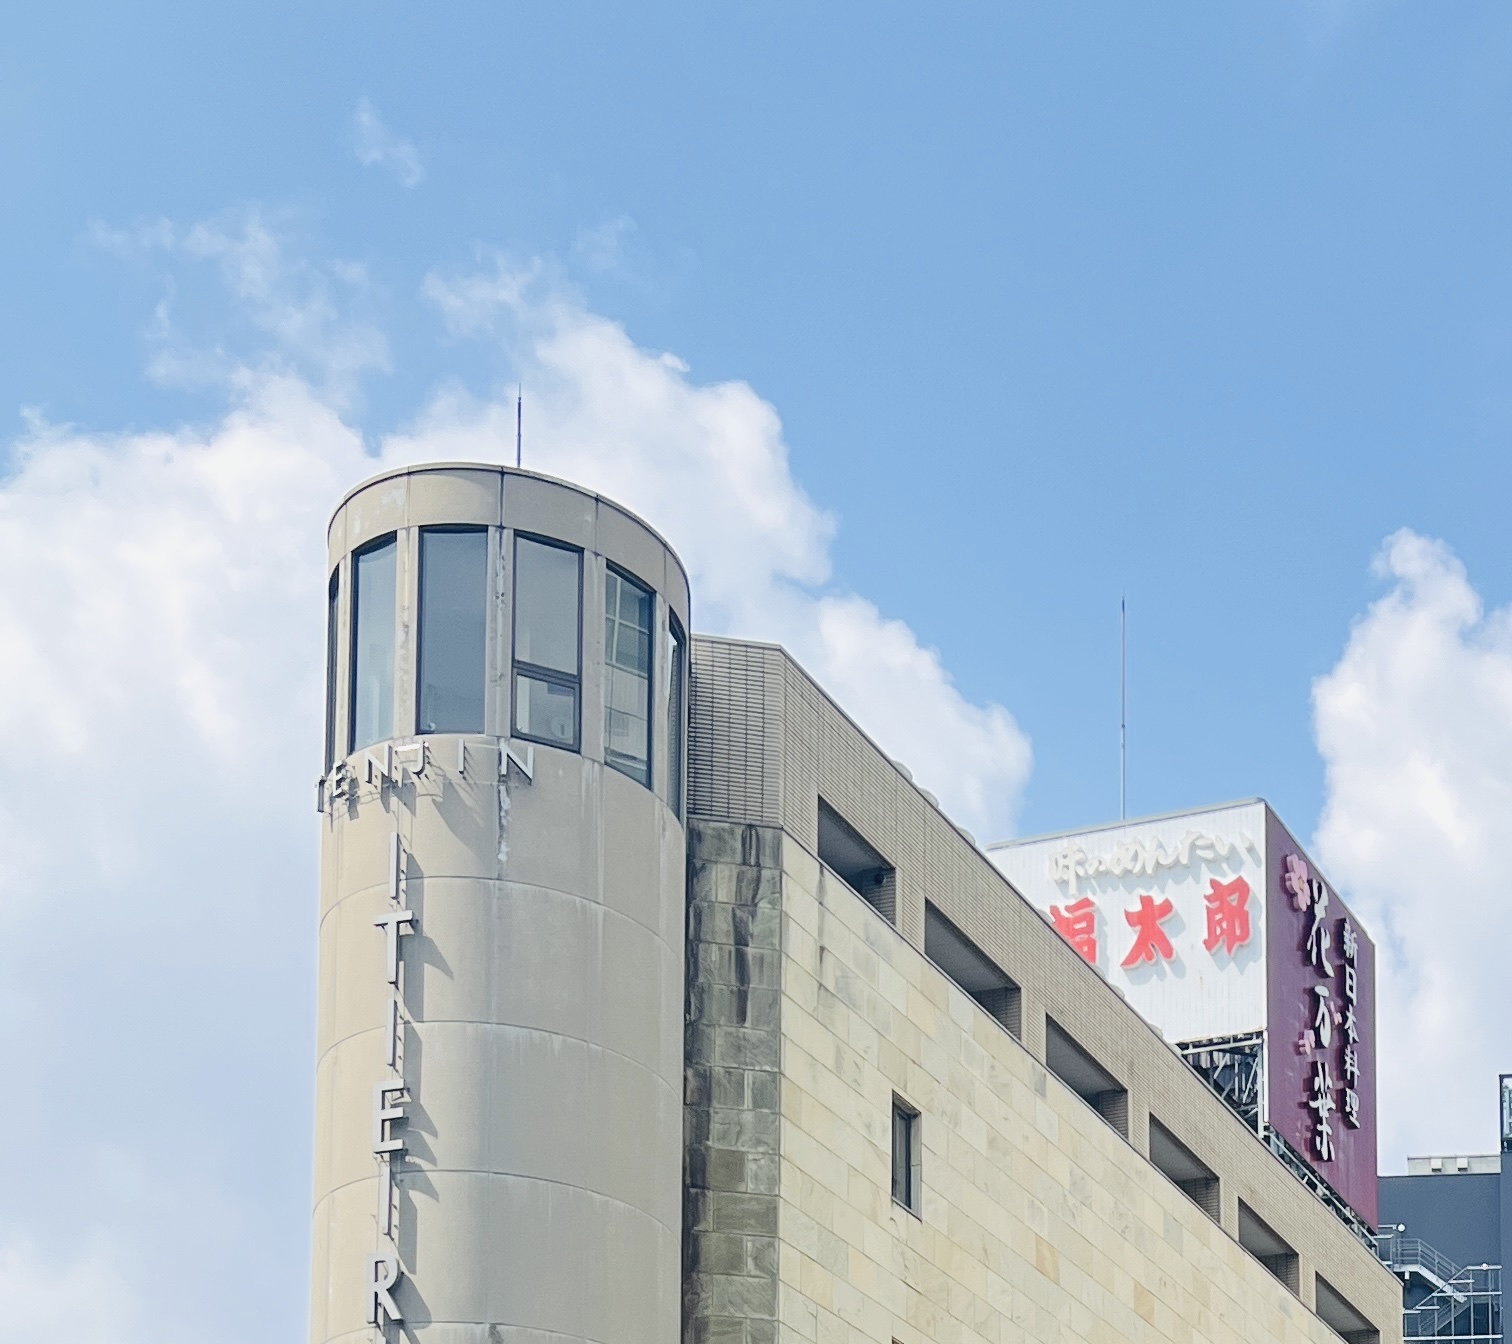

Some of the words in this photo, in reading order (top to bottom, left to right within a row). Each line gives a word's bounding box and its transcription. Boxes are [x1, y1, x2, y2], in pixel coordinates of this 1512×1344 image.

[1048, 831, 1254, 896] 味のめんたい
[1343, 917, 1361, 1130] 新日本料理
